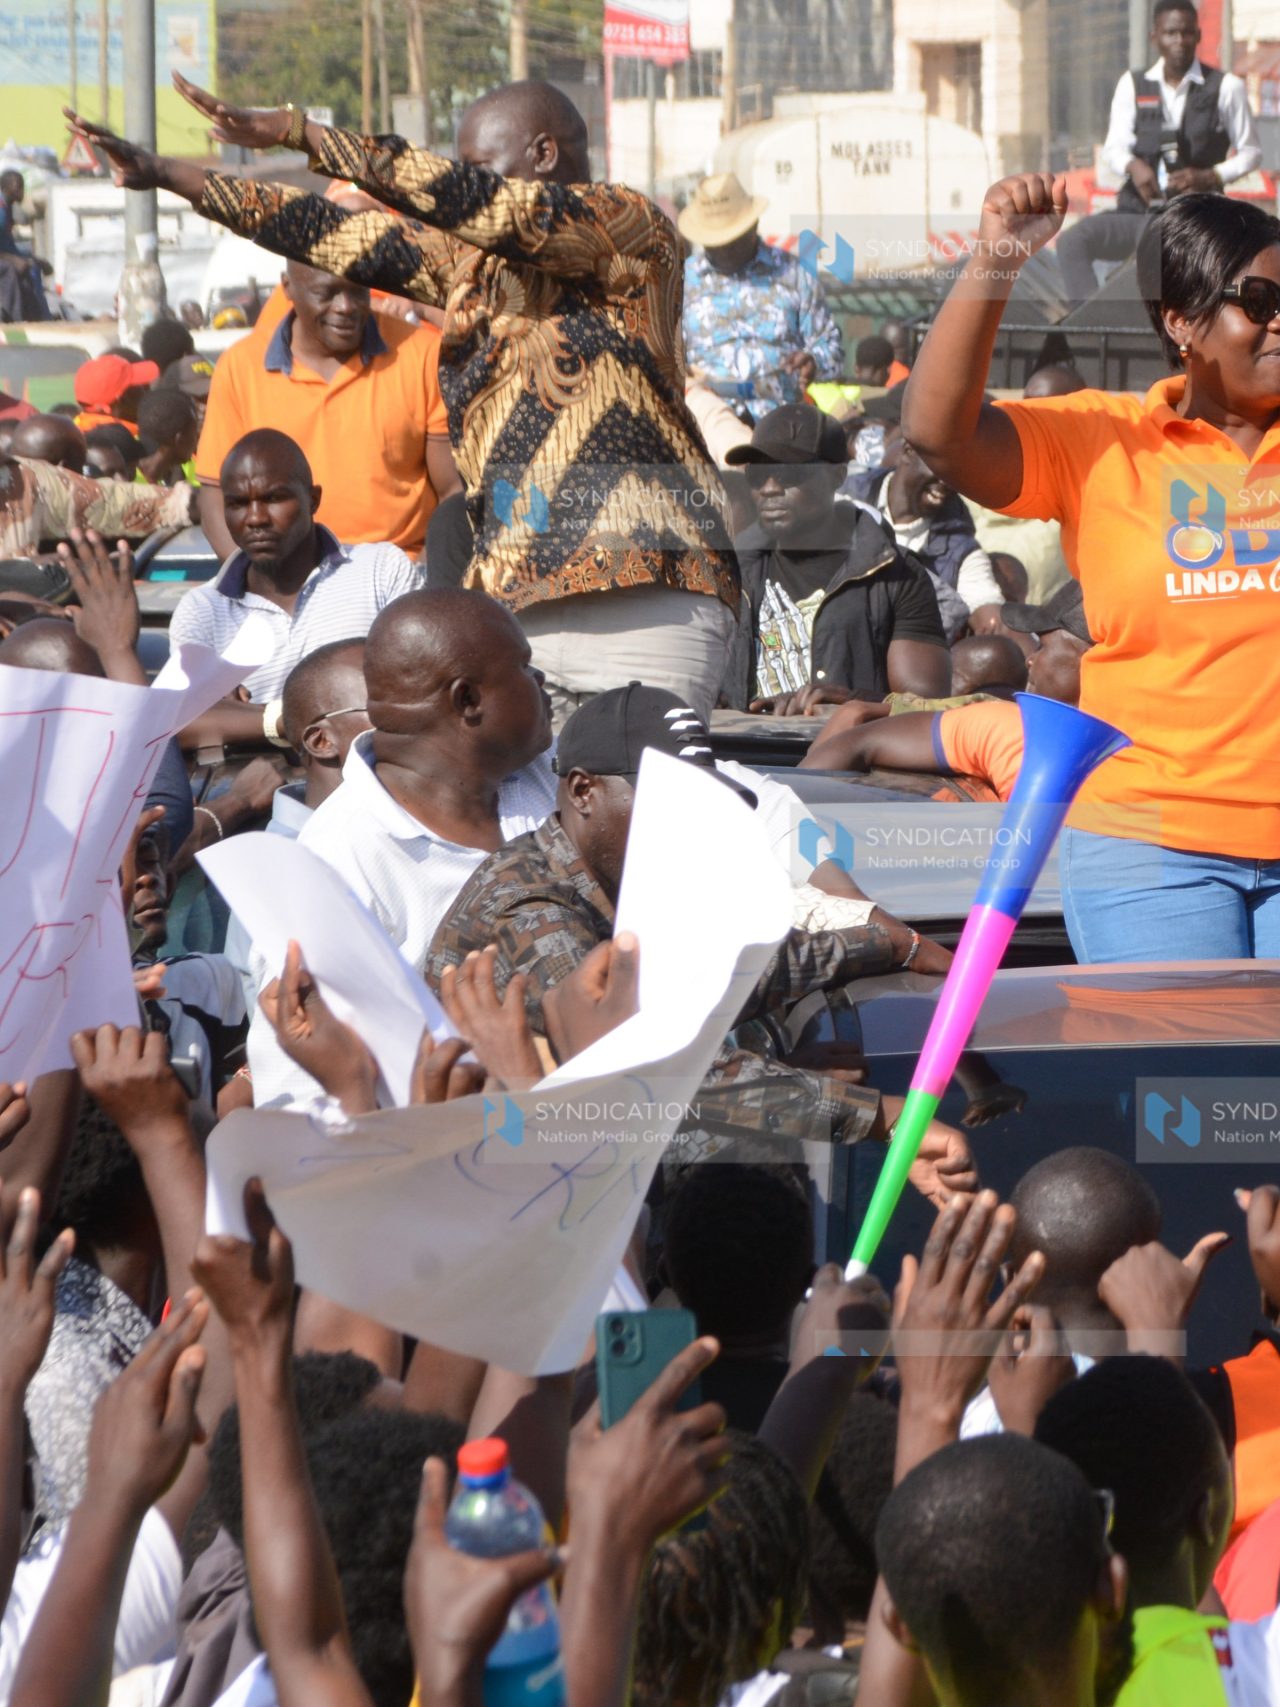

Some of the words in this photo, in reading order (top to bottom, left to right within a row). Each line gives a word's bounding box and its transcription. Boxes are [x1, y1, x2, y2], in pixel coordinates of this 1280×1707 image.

[831, 140, 913, 159] MOLASSES
[854, 160, 891, 176] TANK
[1165, 569, 1266, 597] LINDA
